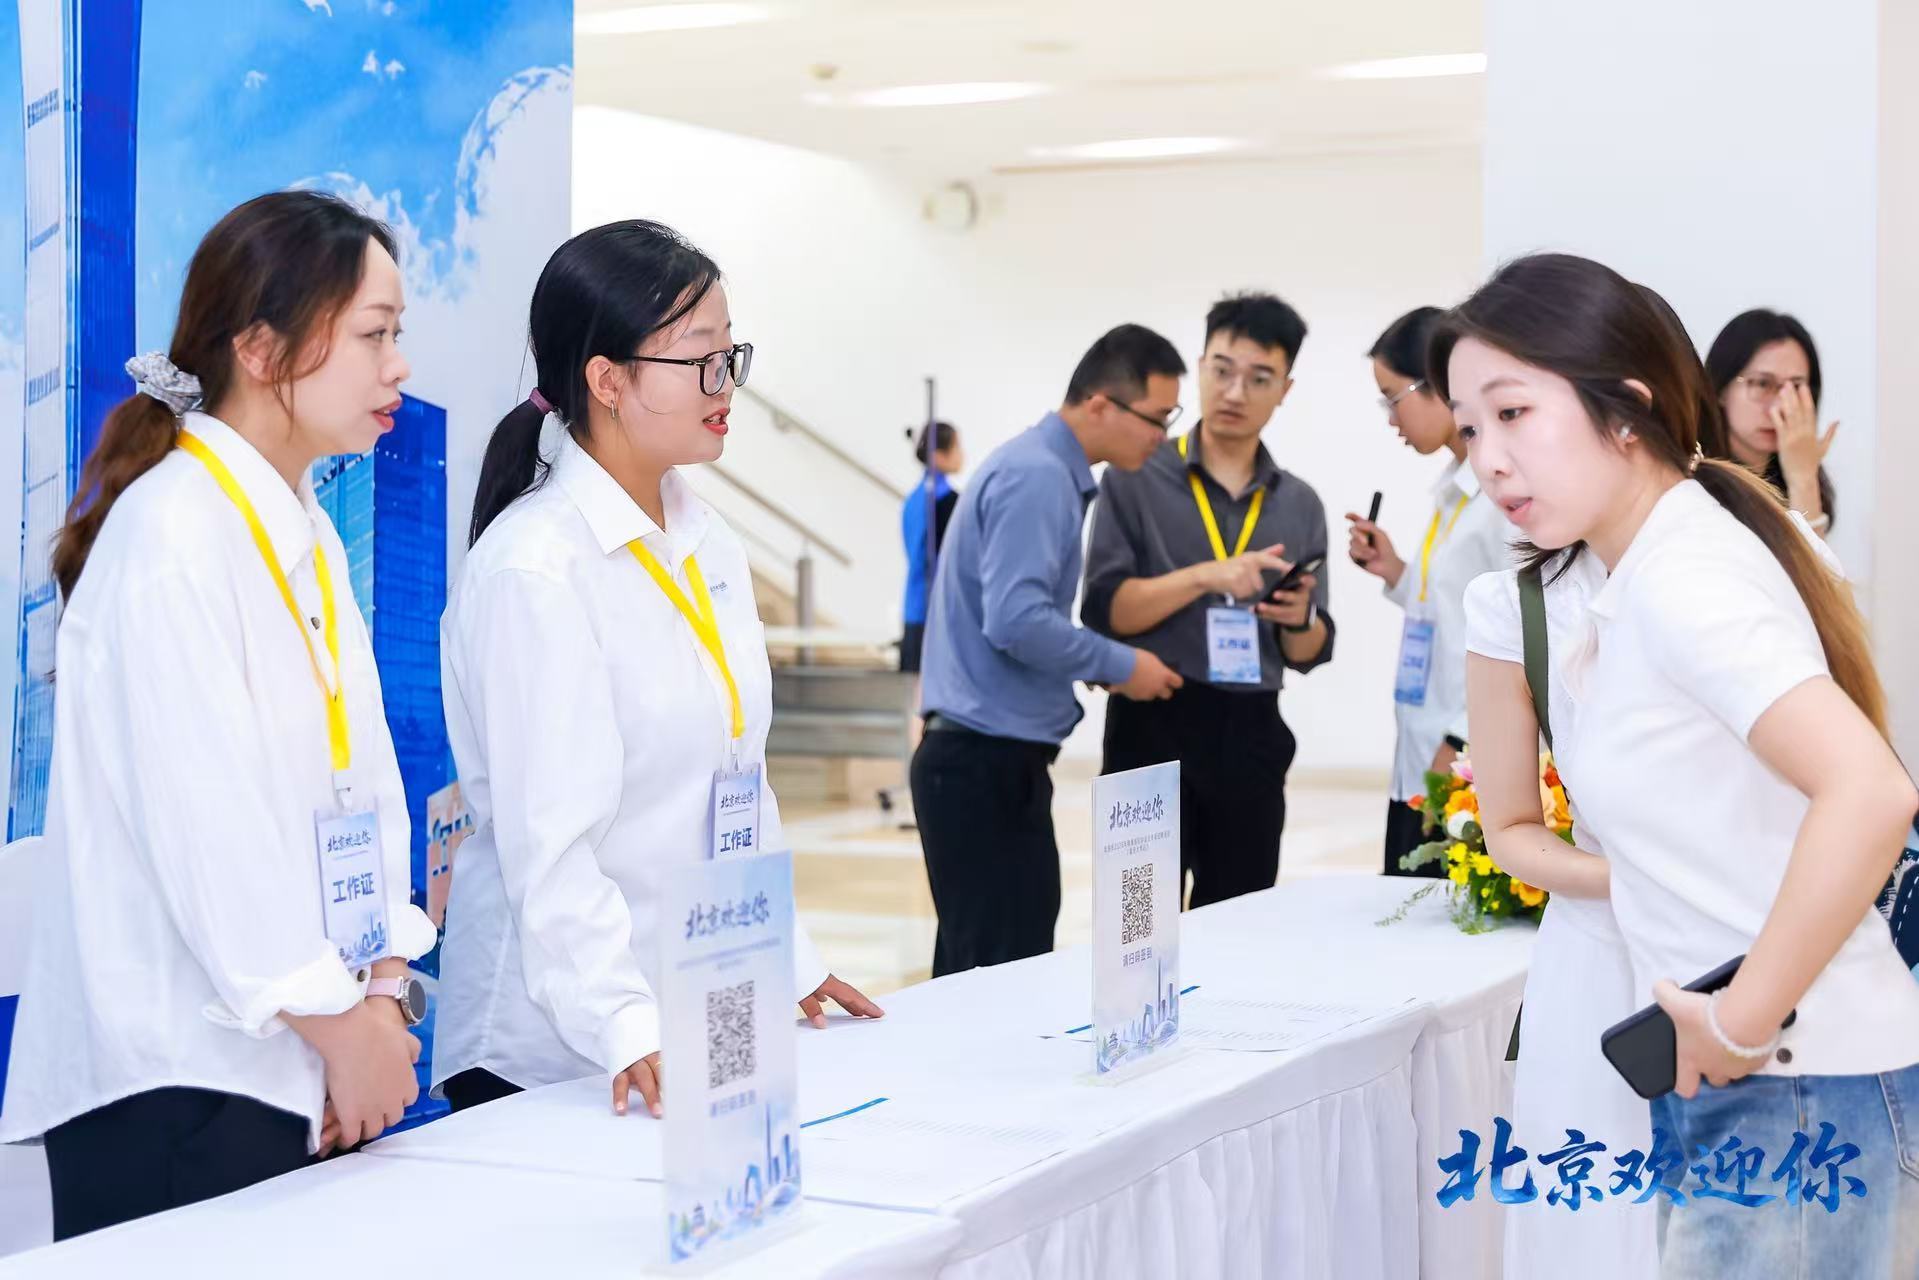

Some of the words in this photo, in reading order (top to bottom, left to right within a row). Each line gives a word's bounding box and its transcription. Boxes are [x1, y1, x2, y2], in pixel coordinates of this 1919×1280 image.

[1109, 793, 1164, 831] 北京欢迎你
[720, 826, 752, 852] 工作证
[332, 872, 375, 903] 工作证
[685, 891, 770, 940] 北京欢迎你
